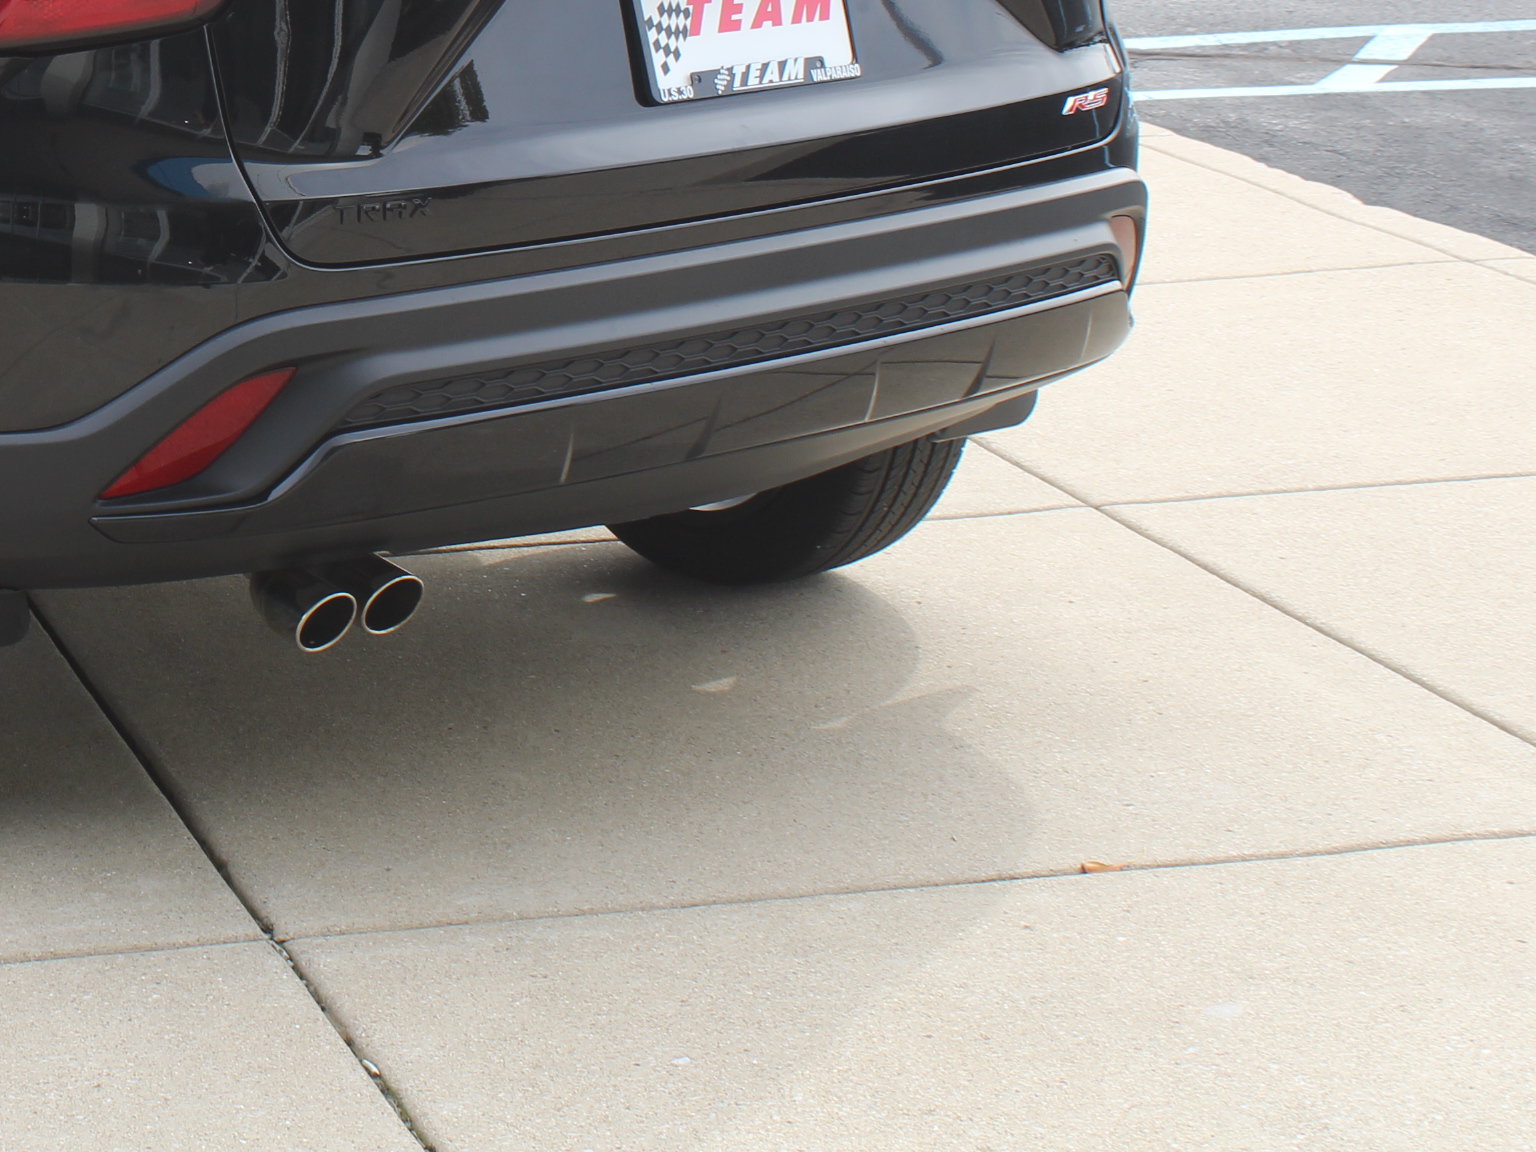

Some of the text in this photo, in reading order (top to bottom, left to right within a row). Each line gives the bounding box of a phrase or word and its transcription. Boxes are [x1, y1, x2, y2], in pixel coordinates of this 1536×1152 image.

[732, 57, 805, 88] TEAM
[811, 63, 861, 83] VALPARAISO
[1061, 87, 1111, 116] RS
[332, 196, 433, 225] TRAX
